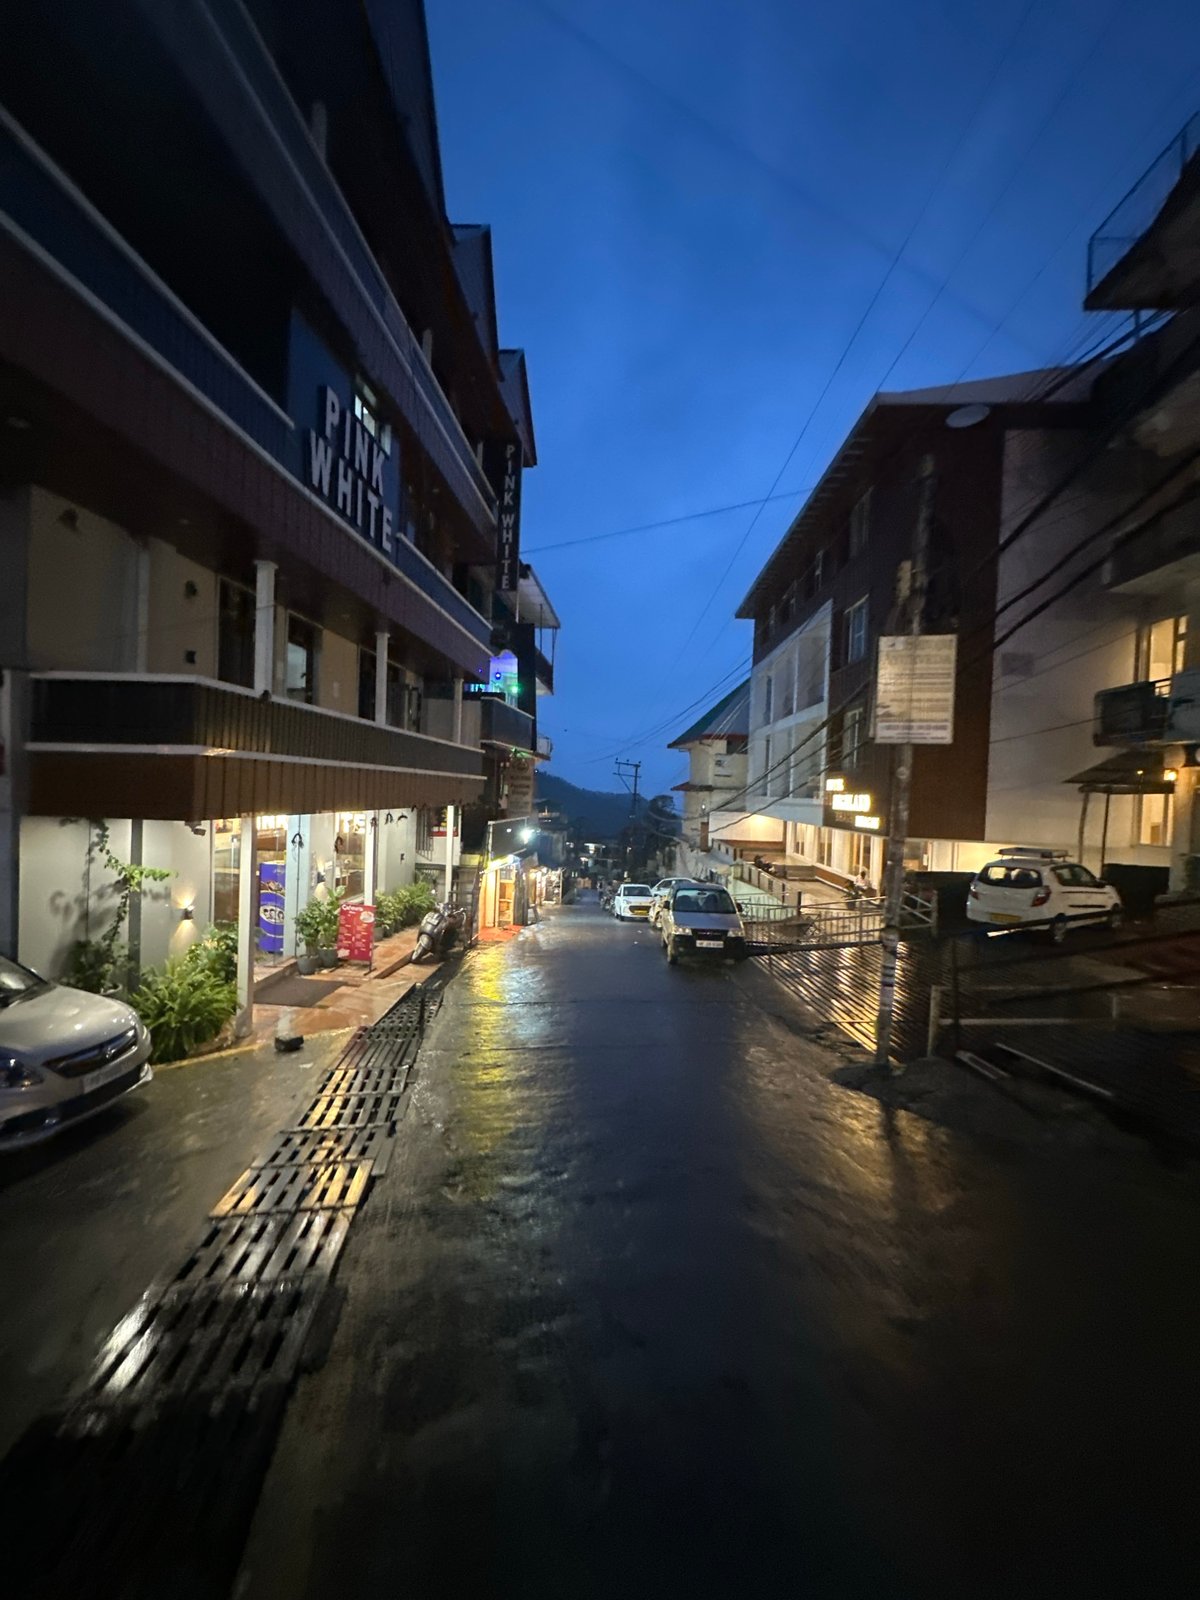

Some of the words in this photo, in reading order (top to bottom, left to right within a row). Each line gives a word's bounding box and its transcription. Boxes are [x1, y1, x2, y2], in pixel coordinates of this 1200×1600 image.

[325, 385, 385, 497] PINK
[504, 445, 515, 505] PINK
[310, 428, 392, 553] WHITE
[501, 514, 514, 589] WHITE
